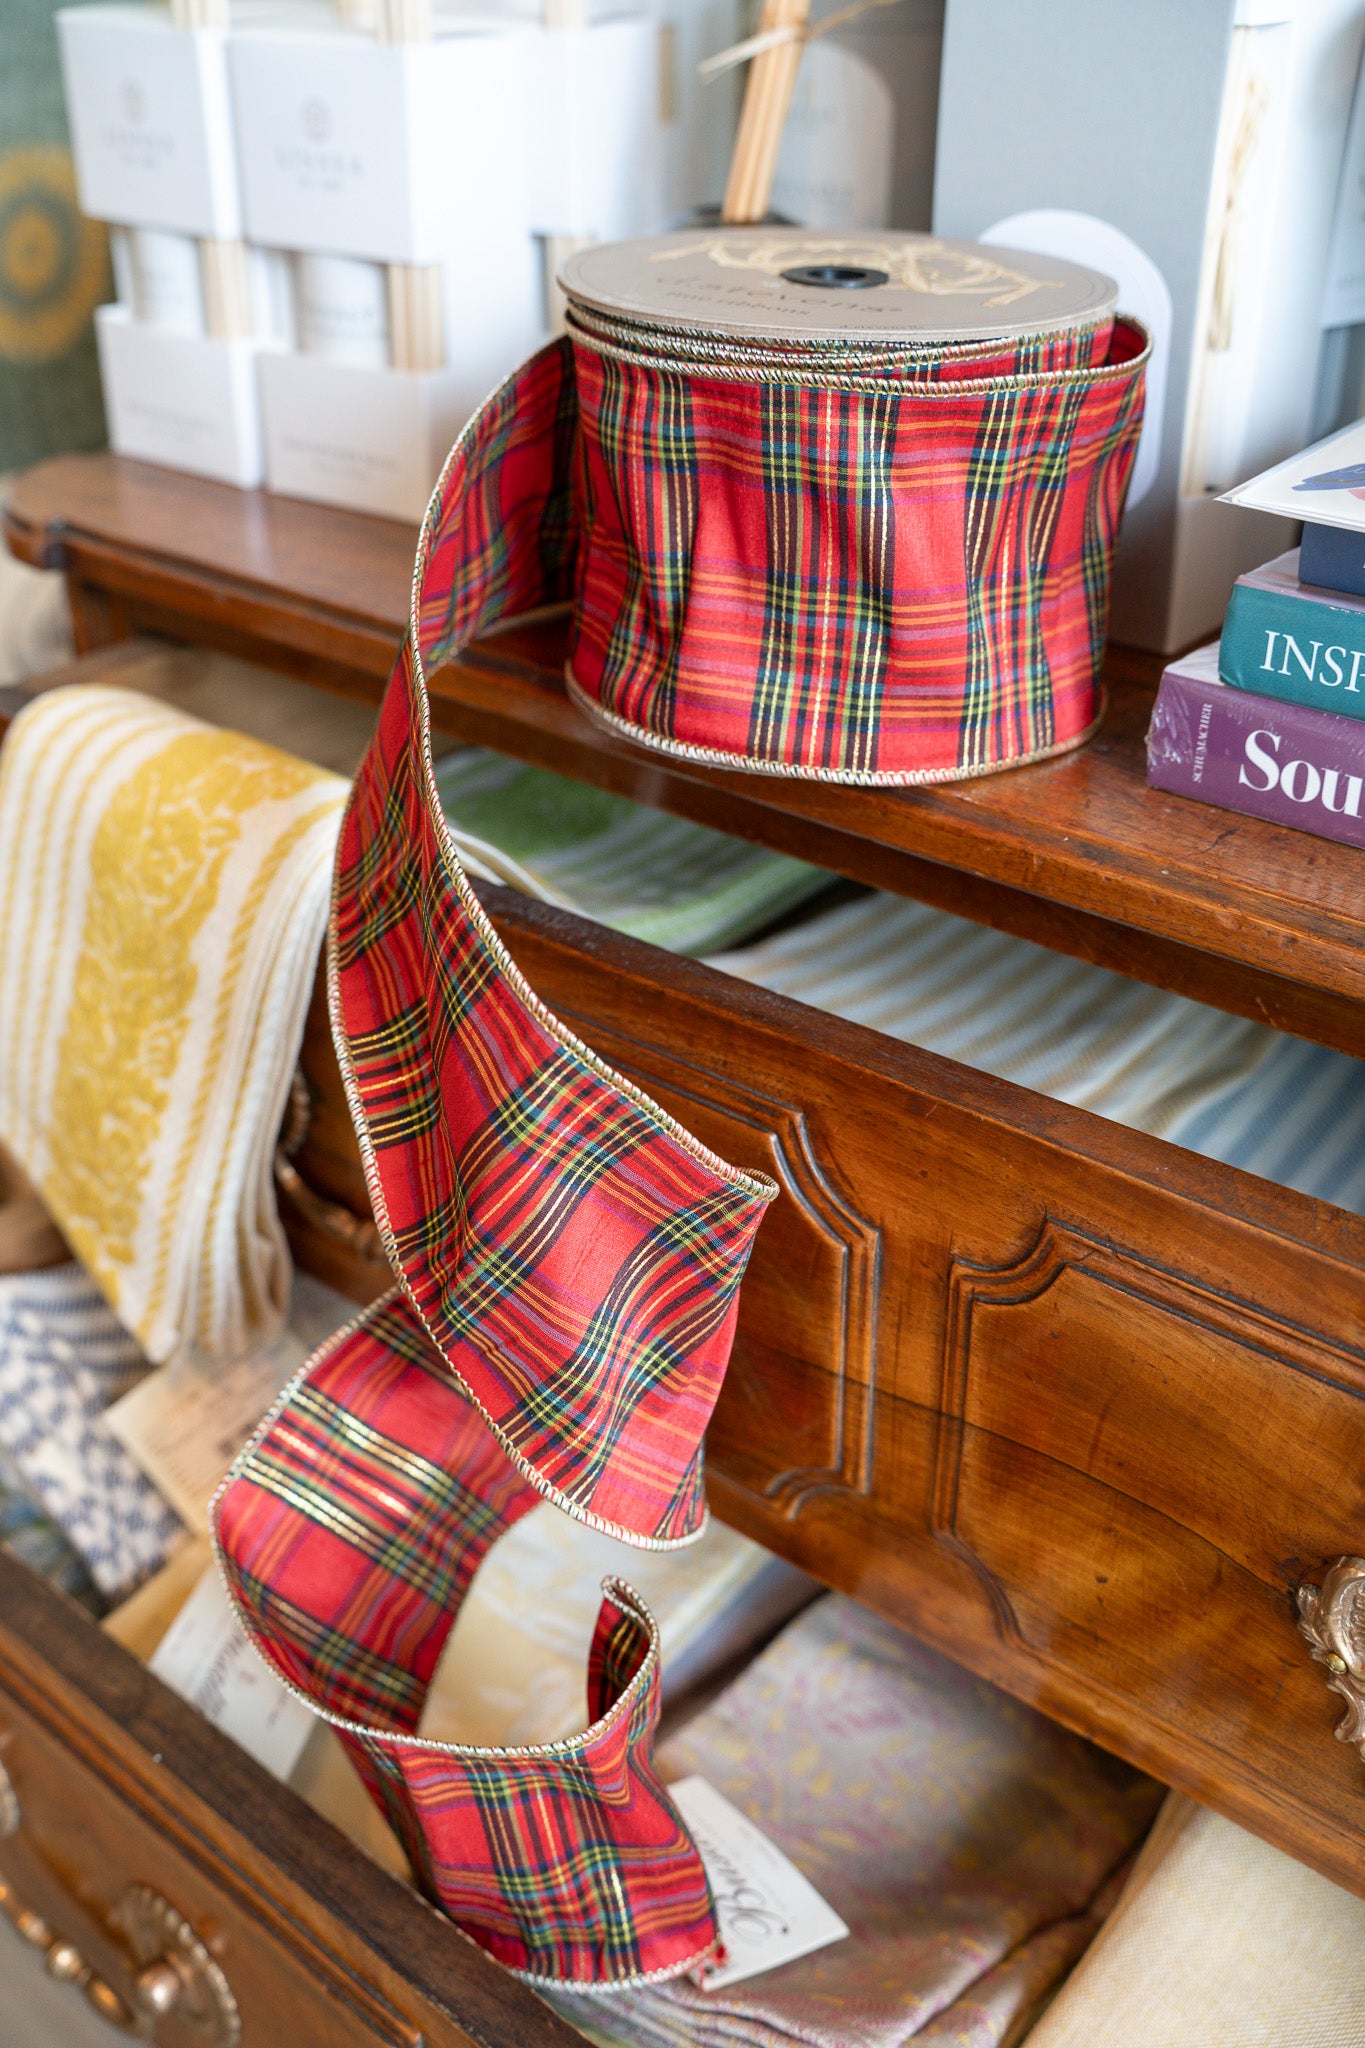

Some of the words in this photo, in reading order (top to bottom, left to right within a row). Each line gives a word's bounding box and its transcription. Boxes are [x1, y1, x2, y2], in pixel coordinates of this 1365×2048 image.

[1259, 629, 1365, 693] INSP
[1192, 702, 1213, 784] SCHUMACHER
[1238, 729, 1364, 819] Sou
